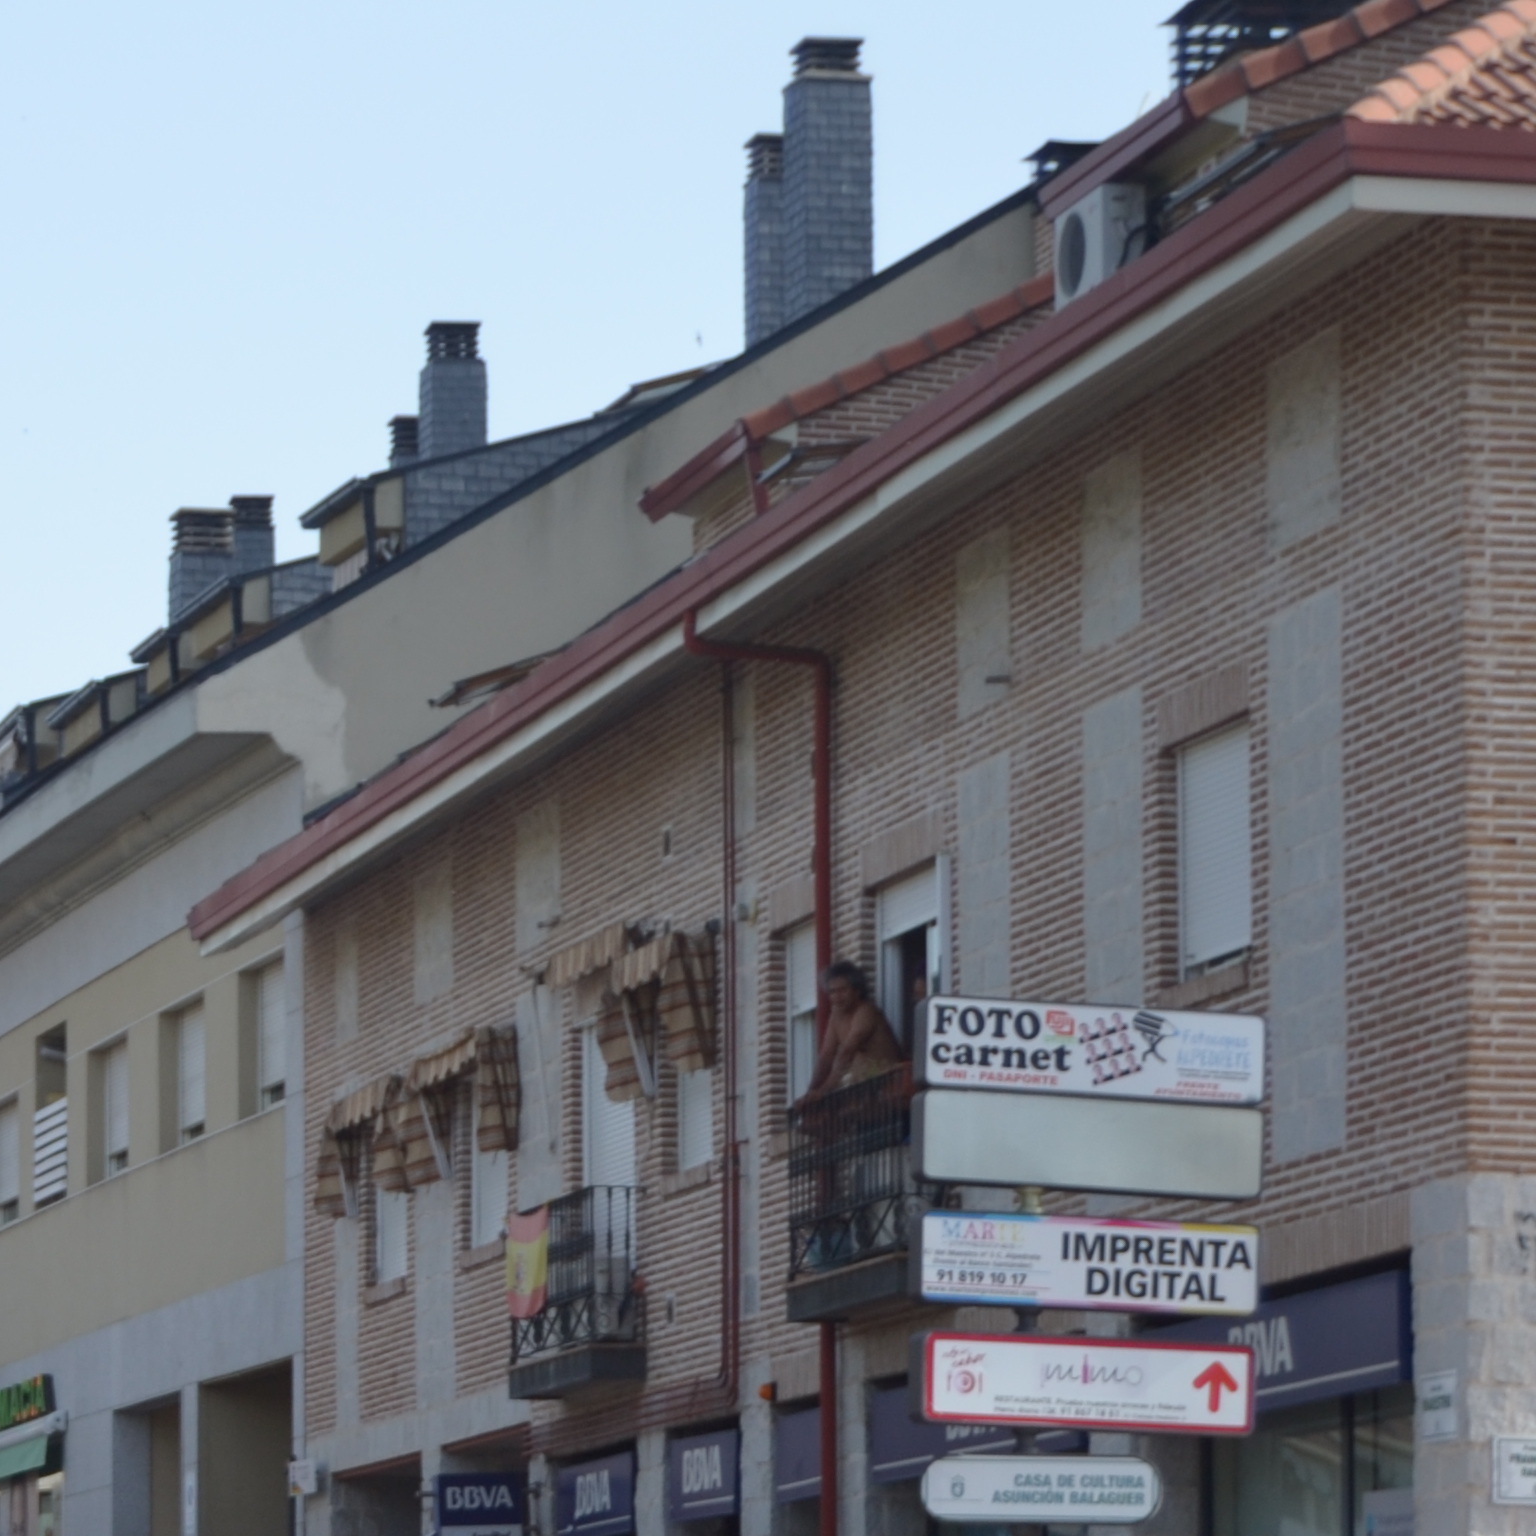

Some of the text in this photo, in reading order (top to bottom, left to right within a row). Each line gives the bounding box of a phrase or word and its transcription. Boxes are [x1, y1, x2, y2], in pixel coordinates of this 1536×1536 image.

[933, 1004, 1041, 1040] FOTO
[931, 1042, 1072, 1072] carnet
[943, 1068, 968, 1081] DNI
[979, 1071, 1059, 1086] PASAPORTE
[1061, 1231, 1252, 1270] IMPRENTA
[936, 1269, 1027, 1286] 91 819 10 17
[1085, 1267, 1226, 1302] DIGITAL
[681, 1444, 722, 1494] BBVA
[1014, 1473, 1145, 1490] CASA DE CULTURA
[445, 1484, 514, 1510] BBVA
[573, 1469, 612, 1518] BBVA
[992, 1488, 1145, 1506] ASUNCIÓN BALAGUER
